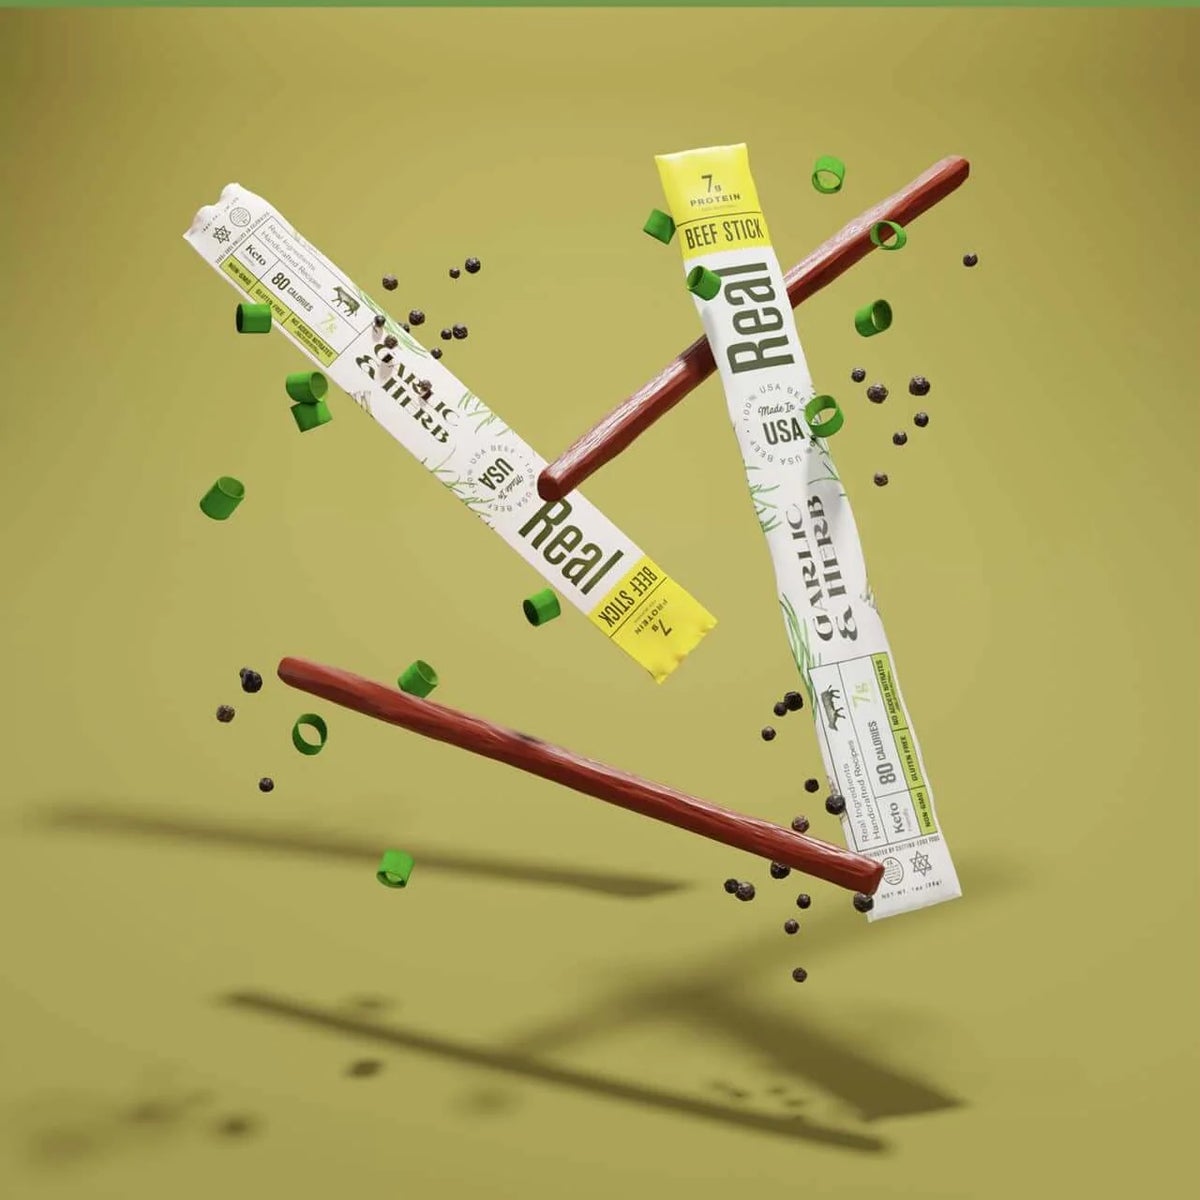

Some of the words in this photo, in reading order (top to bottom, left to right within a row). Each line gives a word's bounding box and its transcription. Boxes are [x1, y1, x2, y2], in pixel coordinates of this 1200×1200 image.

[689, 192, 741, 207] PROTEIN
[700, 173, 722, 193] 7g
[267, 223, 284, 240] Real
[684, 222, 718, 250] BEEF
[721, 210, 765, 242] STICK
[244, 243, 267, 266] Keto
[270, 271, 291, 291] 80
[286, 286, 314, 313] CALORIES
[713, 261, 795, 375] Real
[354, 354, 376, 381] &
[381, 376, 449, 444] HERB
[757, 403, 785, 417] Made
[761, 416, 806, 446] USA
[477, 457, 514, 491] USA
[517, 498, 625, 596] Real
[806, 494, 847, 598] HERB
[628, 565, 658, 597] BEEF
[786, 504, 836, 642] GARLIC
[597, 589, 635, 628] STICK
[633, 598, 668, 635] PROTEIN
[834, 605, 858, 642] &
[650, 618, 673, 637] 7g
[884, 691, 896, 714] ADDED
[890, 714, 899, 726] NO
[867, 719, 887, 761] CALORIES
[899, 735, 910, 753] FREE
[847, 739, 863, 777] Recipes
[875, 761, 897, 785] 80
[905, 753, 919, 782] GLUTEN
[842, 762, 864, 818] Ingredients
[856, 778, 882, 840] Handcrafted
[889, 801, 905, 834] Keto
[915, 791, 931, 827] NON-GMO
[856, 819, 870, 843] Real
